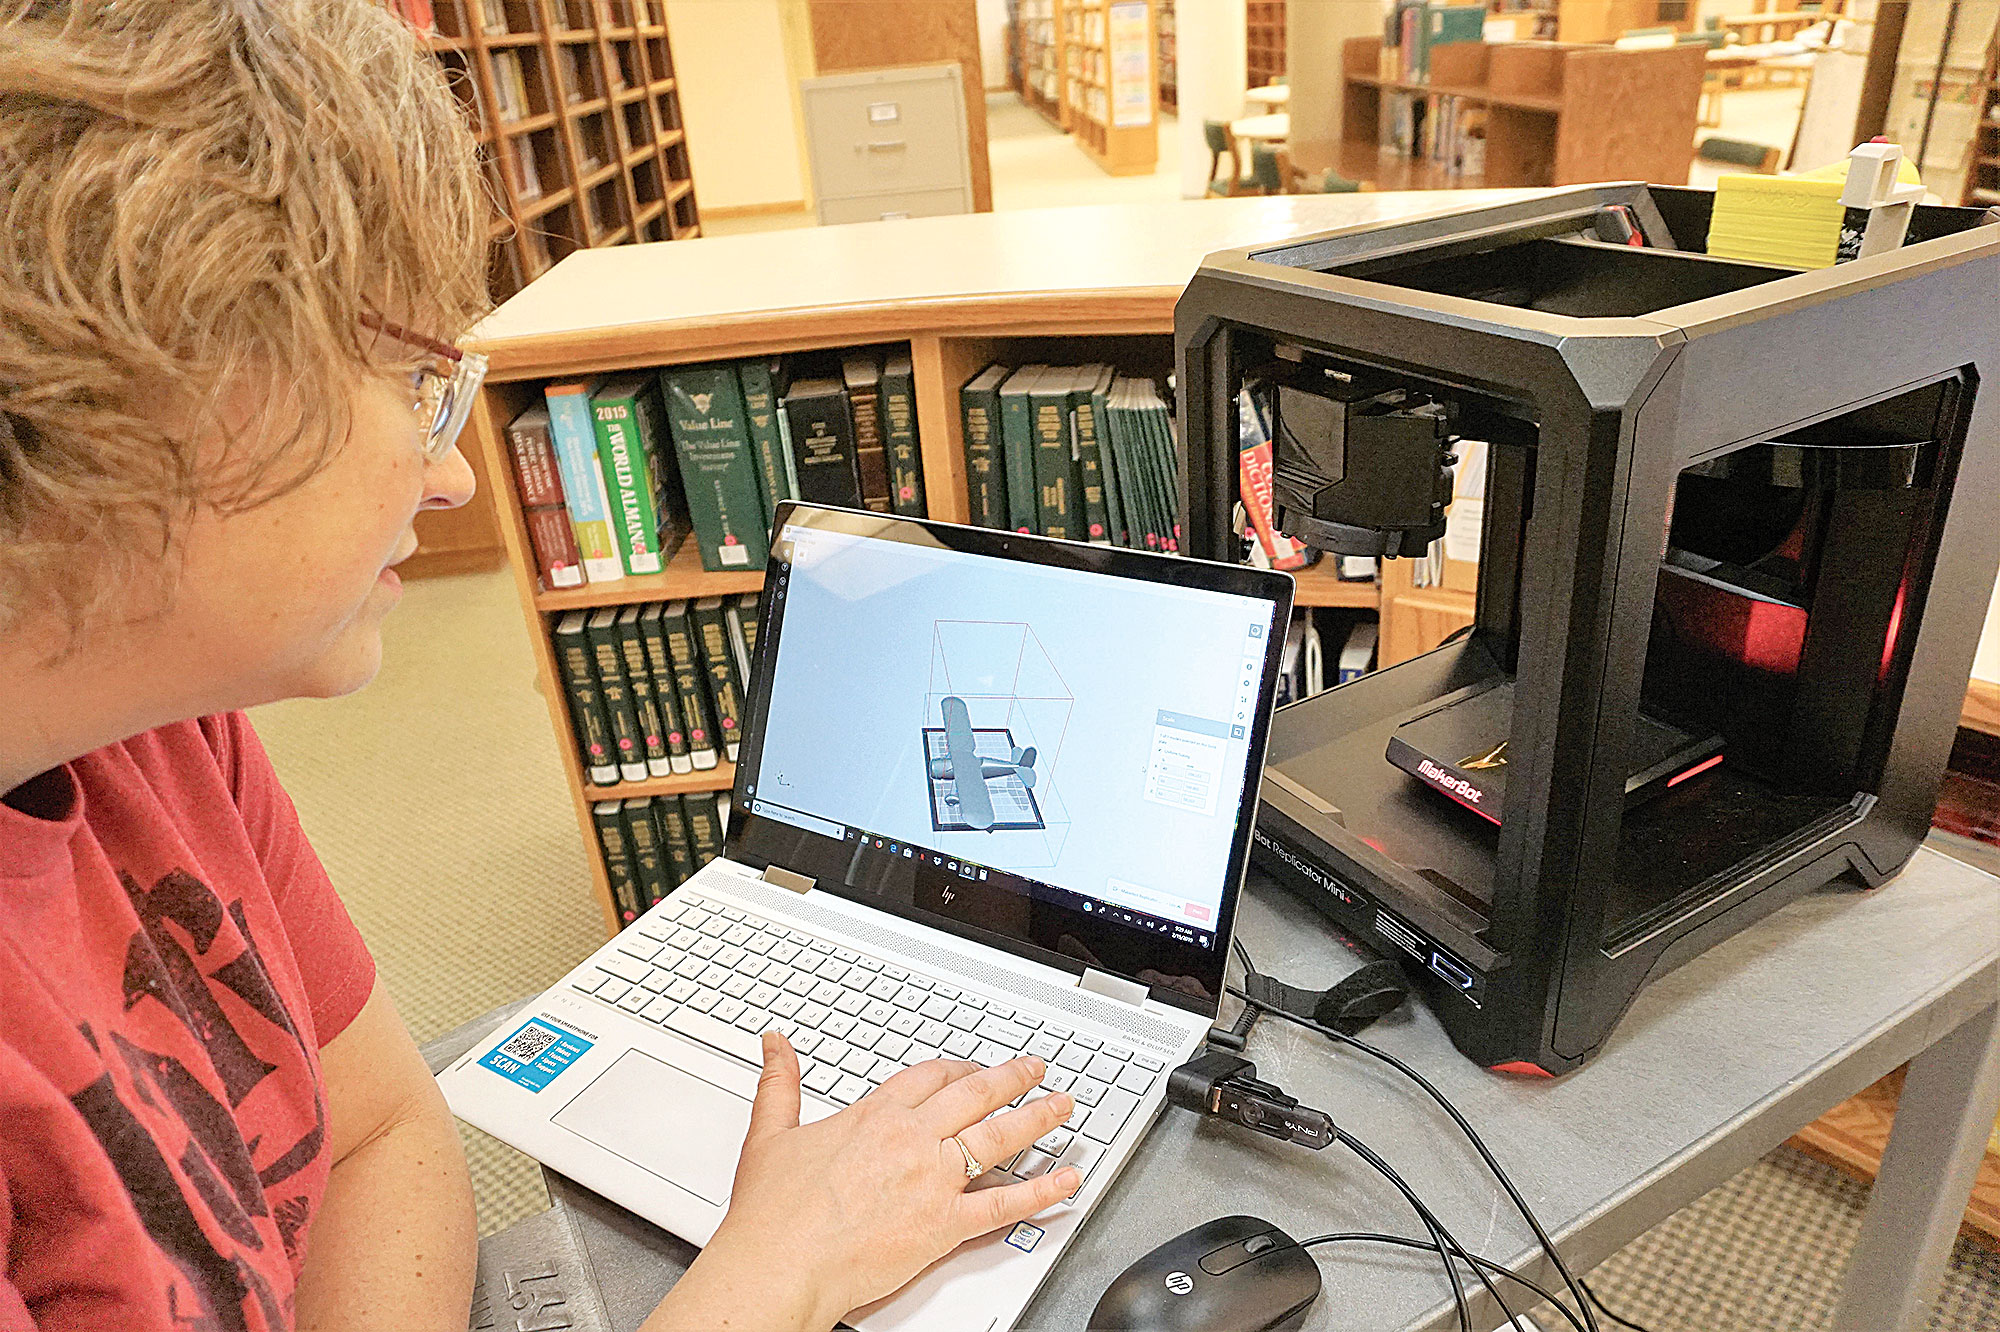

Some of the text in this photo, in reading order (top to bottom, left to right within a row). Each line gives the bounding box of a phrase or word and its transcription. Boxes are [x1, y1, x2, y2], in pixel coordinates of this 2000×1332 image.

[596, 405, 628, 421] 2015
[679, 417, 734, 431] Value Line
[609, 431, 633, 487] WORLD
[620, 488, 647, 555] ALMAN
[1417, 759, 1483, 803] MakerBot
[1273, 841, 1322, 884] Replicator
[541, 1011, 599, 1041] USE YOUR SMARTPHONE FOR
[1122, 1034, 1139, 1045] BANG
[489, 1055, 521, 1074] SCAN
[1168, 1274, 1192, 1291] hp
